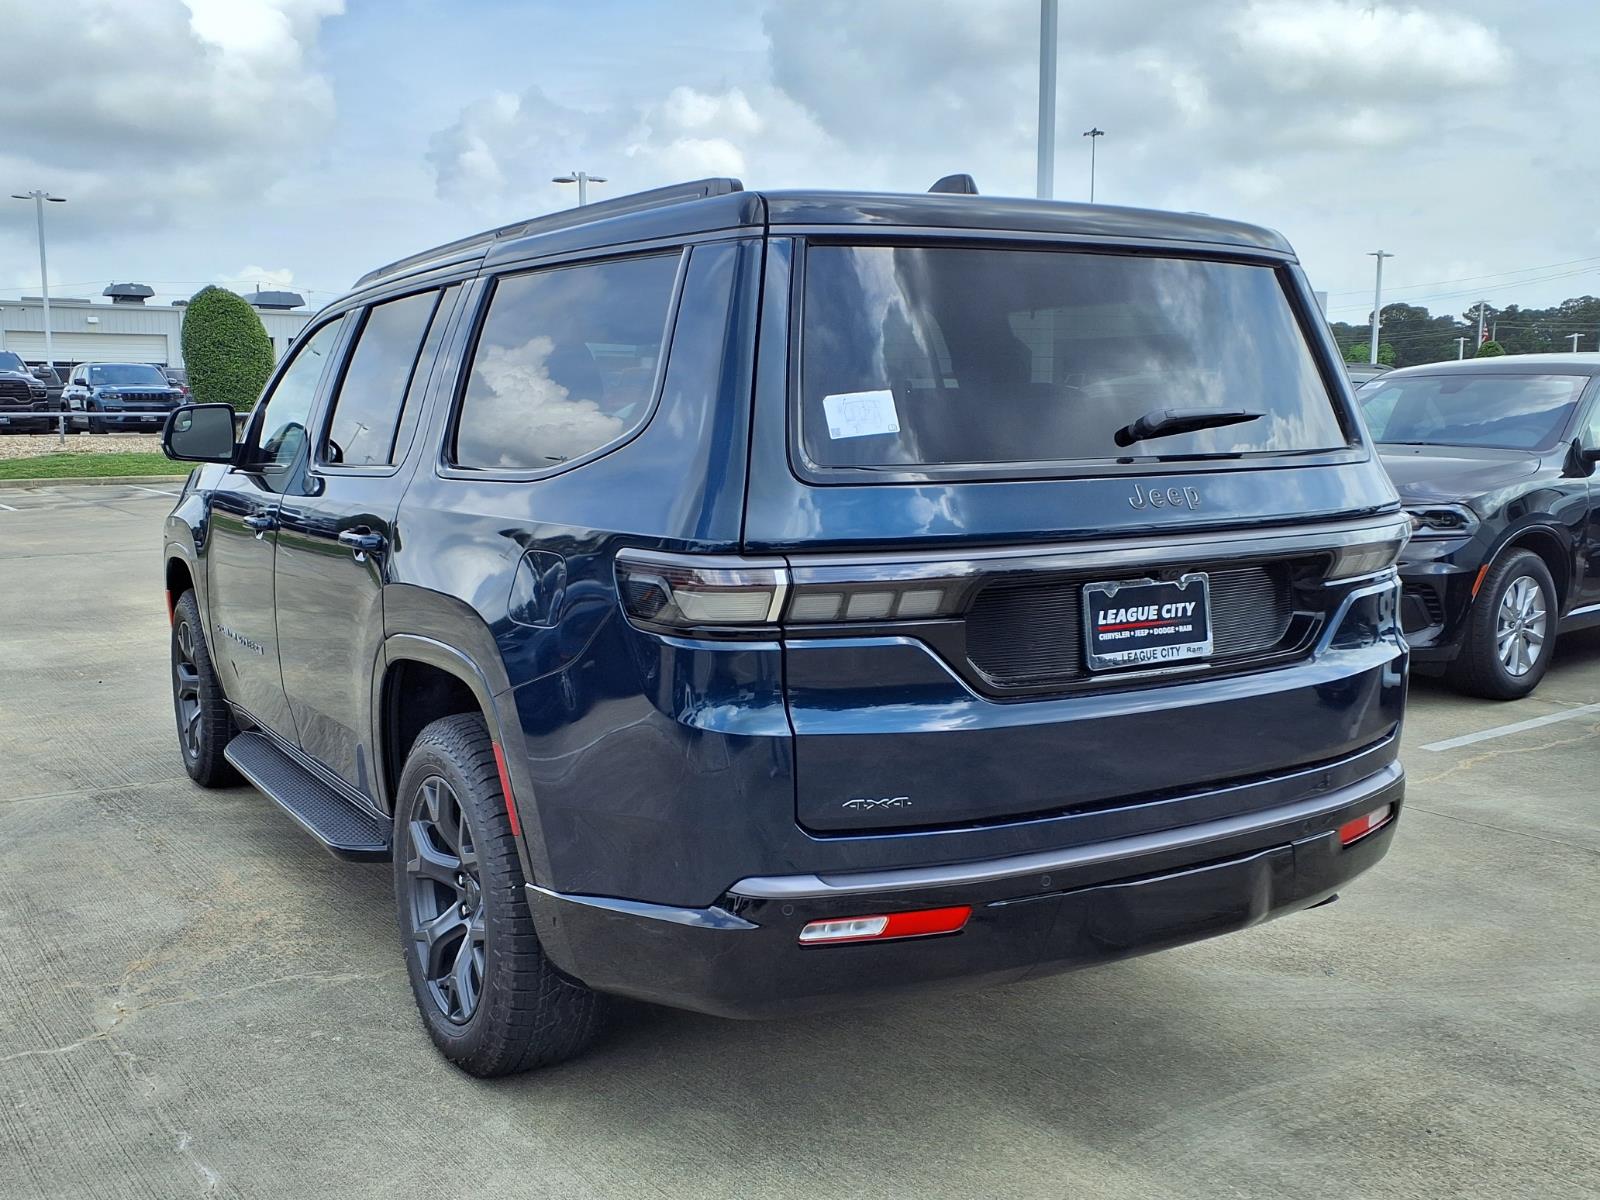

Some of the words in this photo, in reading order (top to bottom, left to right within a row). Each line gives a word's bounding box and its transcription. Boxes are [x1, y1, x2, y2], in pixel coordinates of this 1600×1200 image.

[1128, 483, 1201, 510] Jeep
[1098, 605, 1158, 625] LEAGUE
[1161, 602, 1196, 619] CITY
[1098, 631, 1131, 641] CHRYSLER
[1134, 629, 1149, 637] JEEP
[1153, 626, 1175, 635] DODGE
[1179, 624, 1193, 632] RAM
[1121, 649, 1158, 662] LEAGUE
[1160, 646, 1181, 659] CITY
